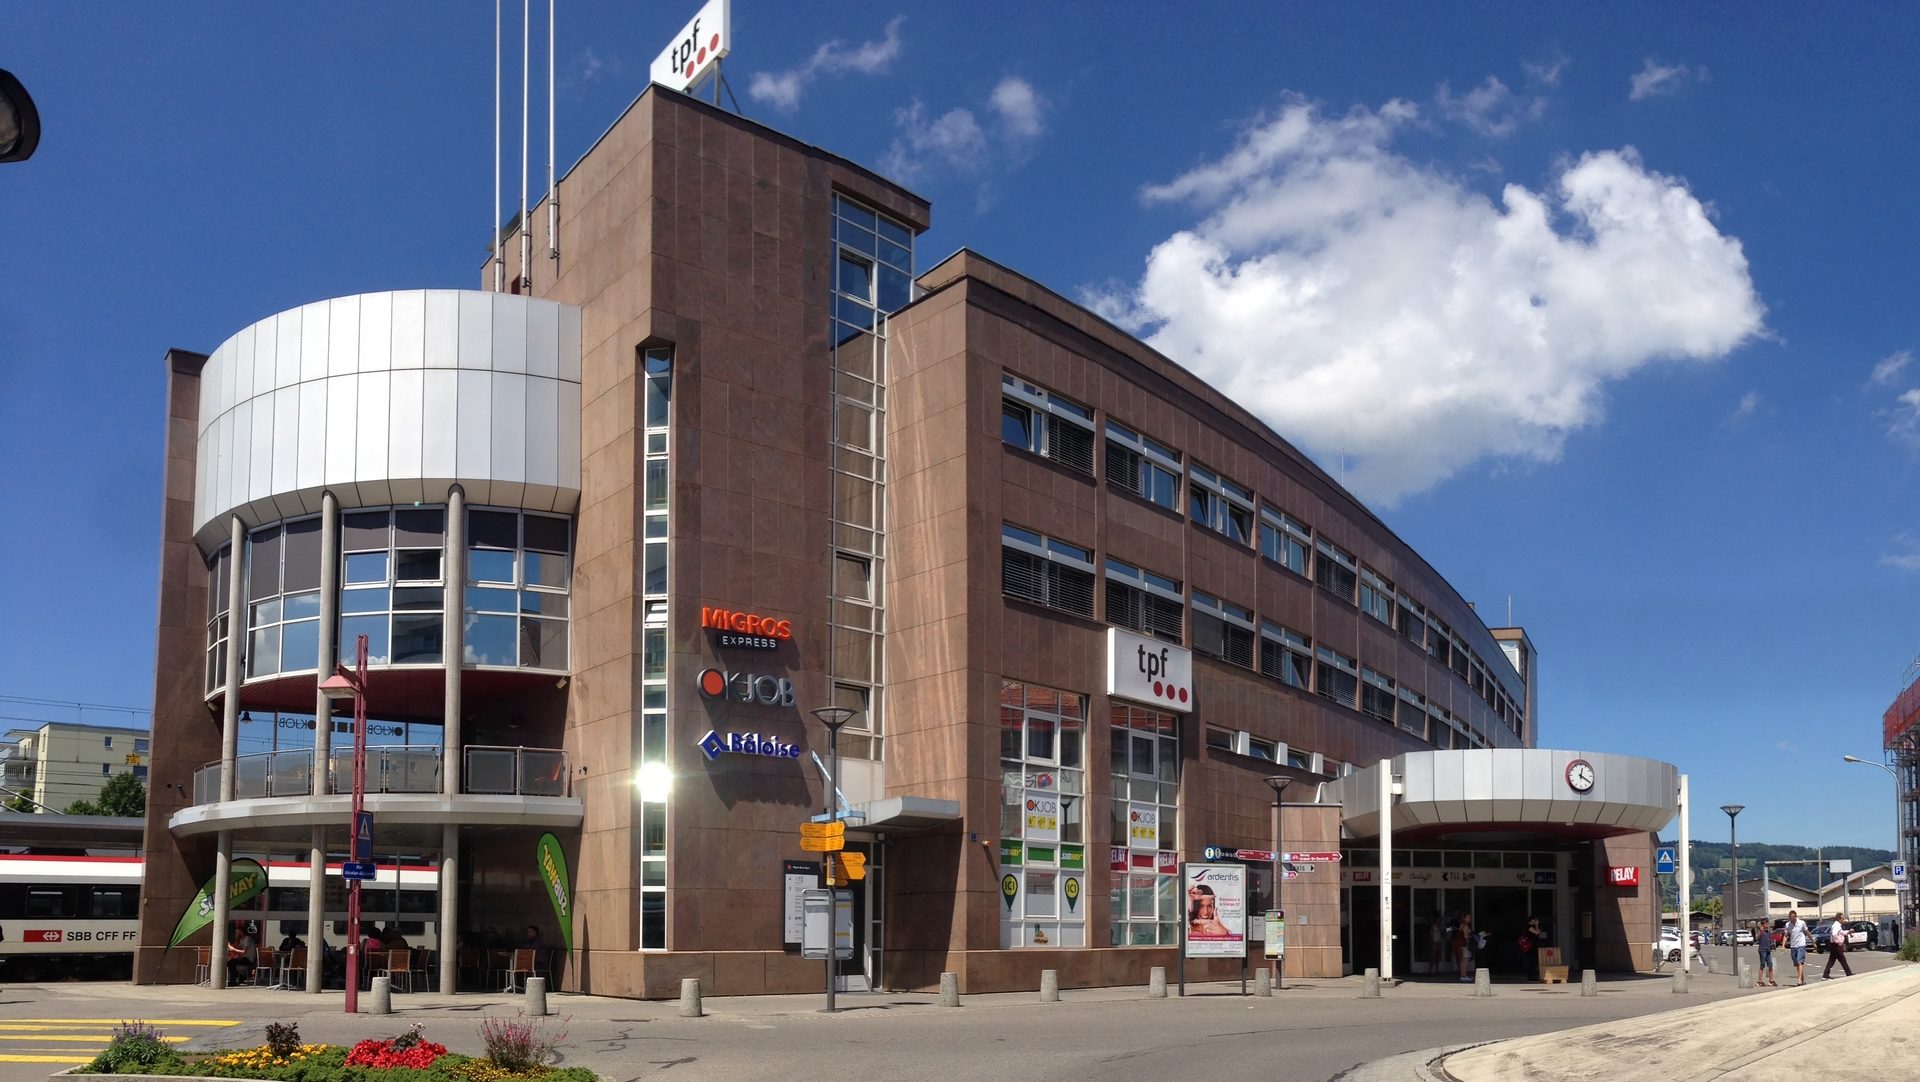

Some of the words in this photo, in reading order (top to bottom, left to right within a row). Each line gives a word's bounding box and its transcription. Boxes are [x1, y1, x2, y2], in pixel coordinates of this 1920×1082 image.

[672, 18, 700, 74] tpf
[702, 607, 792, 640] MIGROS
[722, 635, 776, 648] EXPRESS
[1138, 644, 1168, 682] tpf
[727, 732, 800, 759] Bâloise
[1027, 799, 1057, 813] OKJOB
[1111, 848, 1125, 863] ELAY
[1611, 867, 1634, 882] RELAY
[1004, 881, 1015, 890] ICI
[1067, 884, 1076, 893] ICI
[67, 931, 92, 941] SBB
[96, 931, 119, 941] CFF
